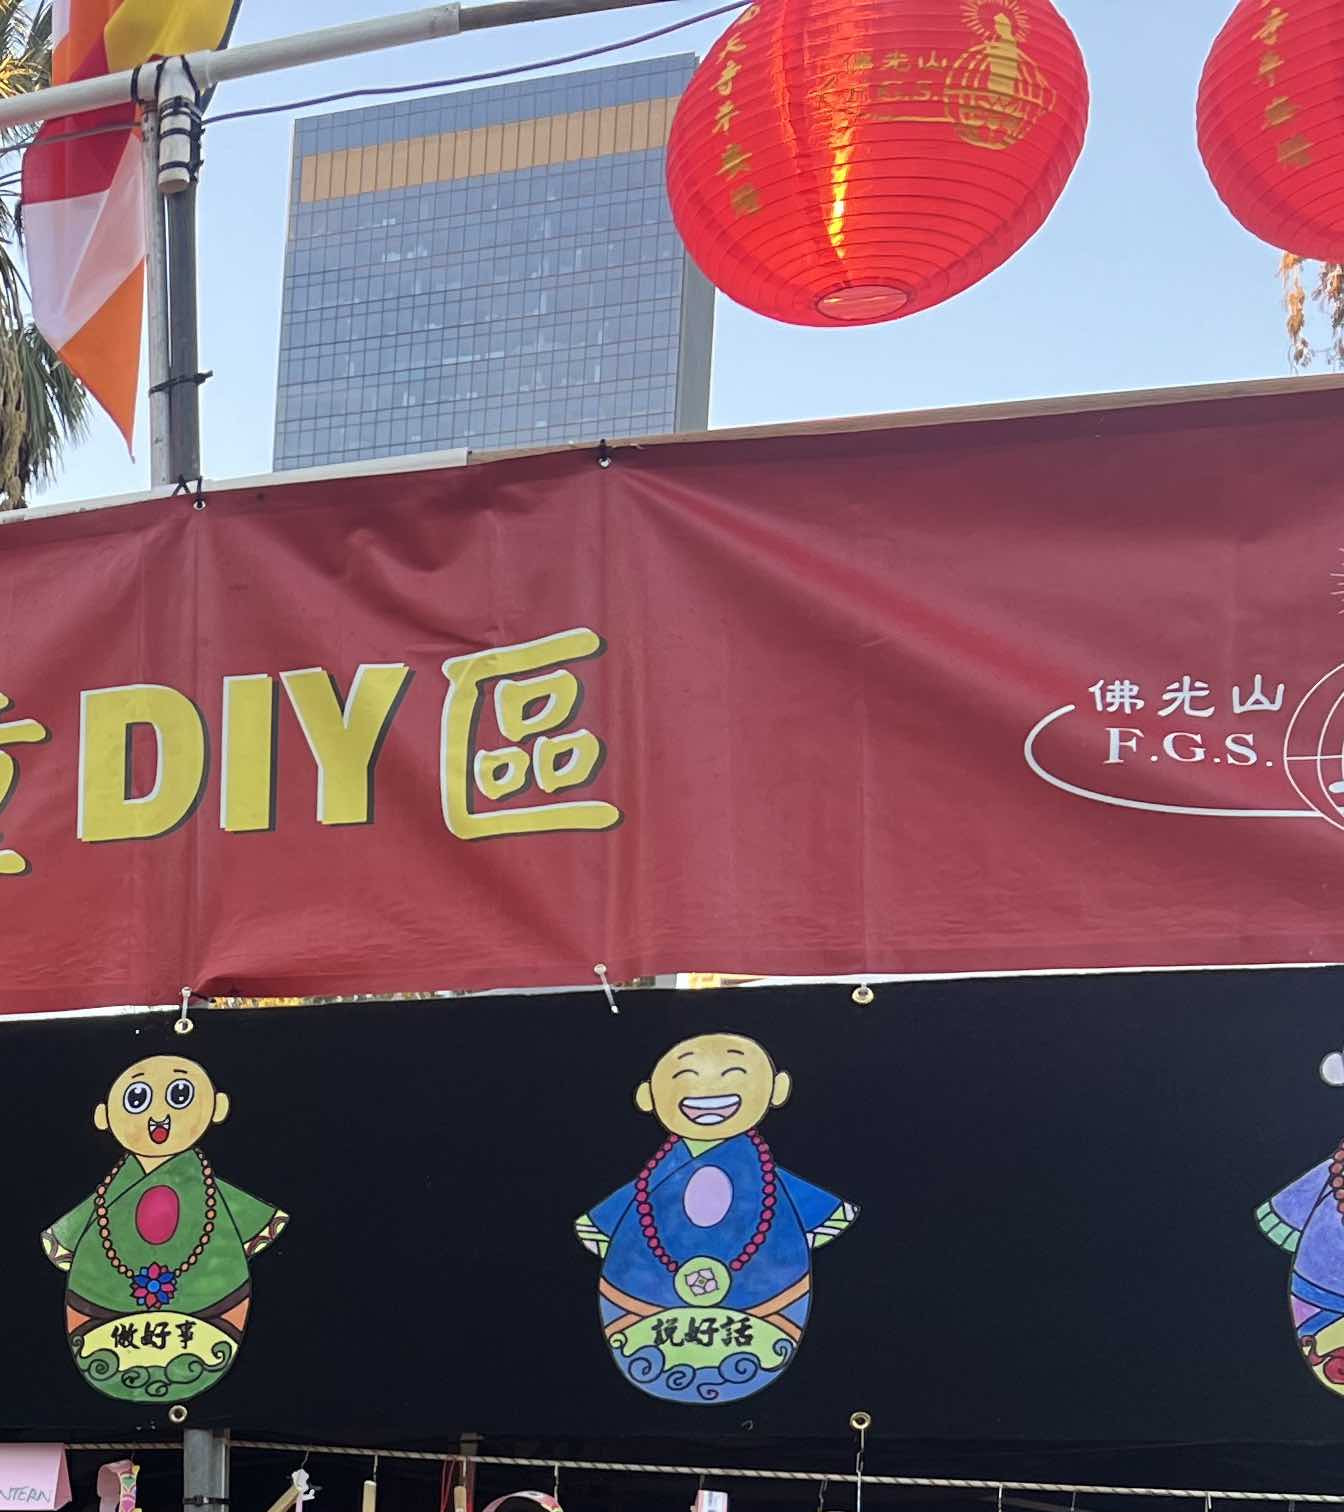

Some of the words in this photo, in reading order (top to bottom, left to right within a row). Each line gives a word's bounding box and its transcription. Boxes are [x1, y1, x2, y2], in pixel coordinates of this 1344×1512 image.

[1088, 673, 1285, 718] 佛光山
[1103, 726, 1274, 768] F.G.S.
[111, 1319, 197, 1350] 做好事
